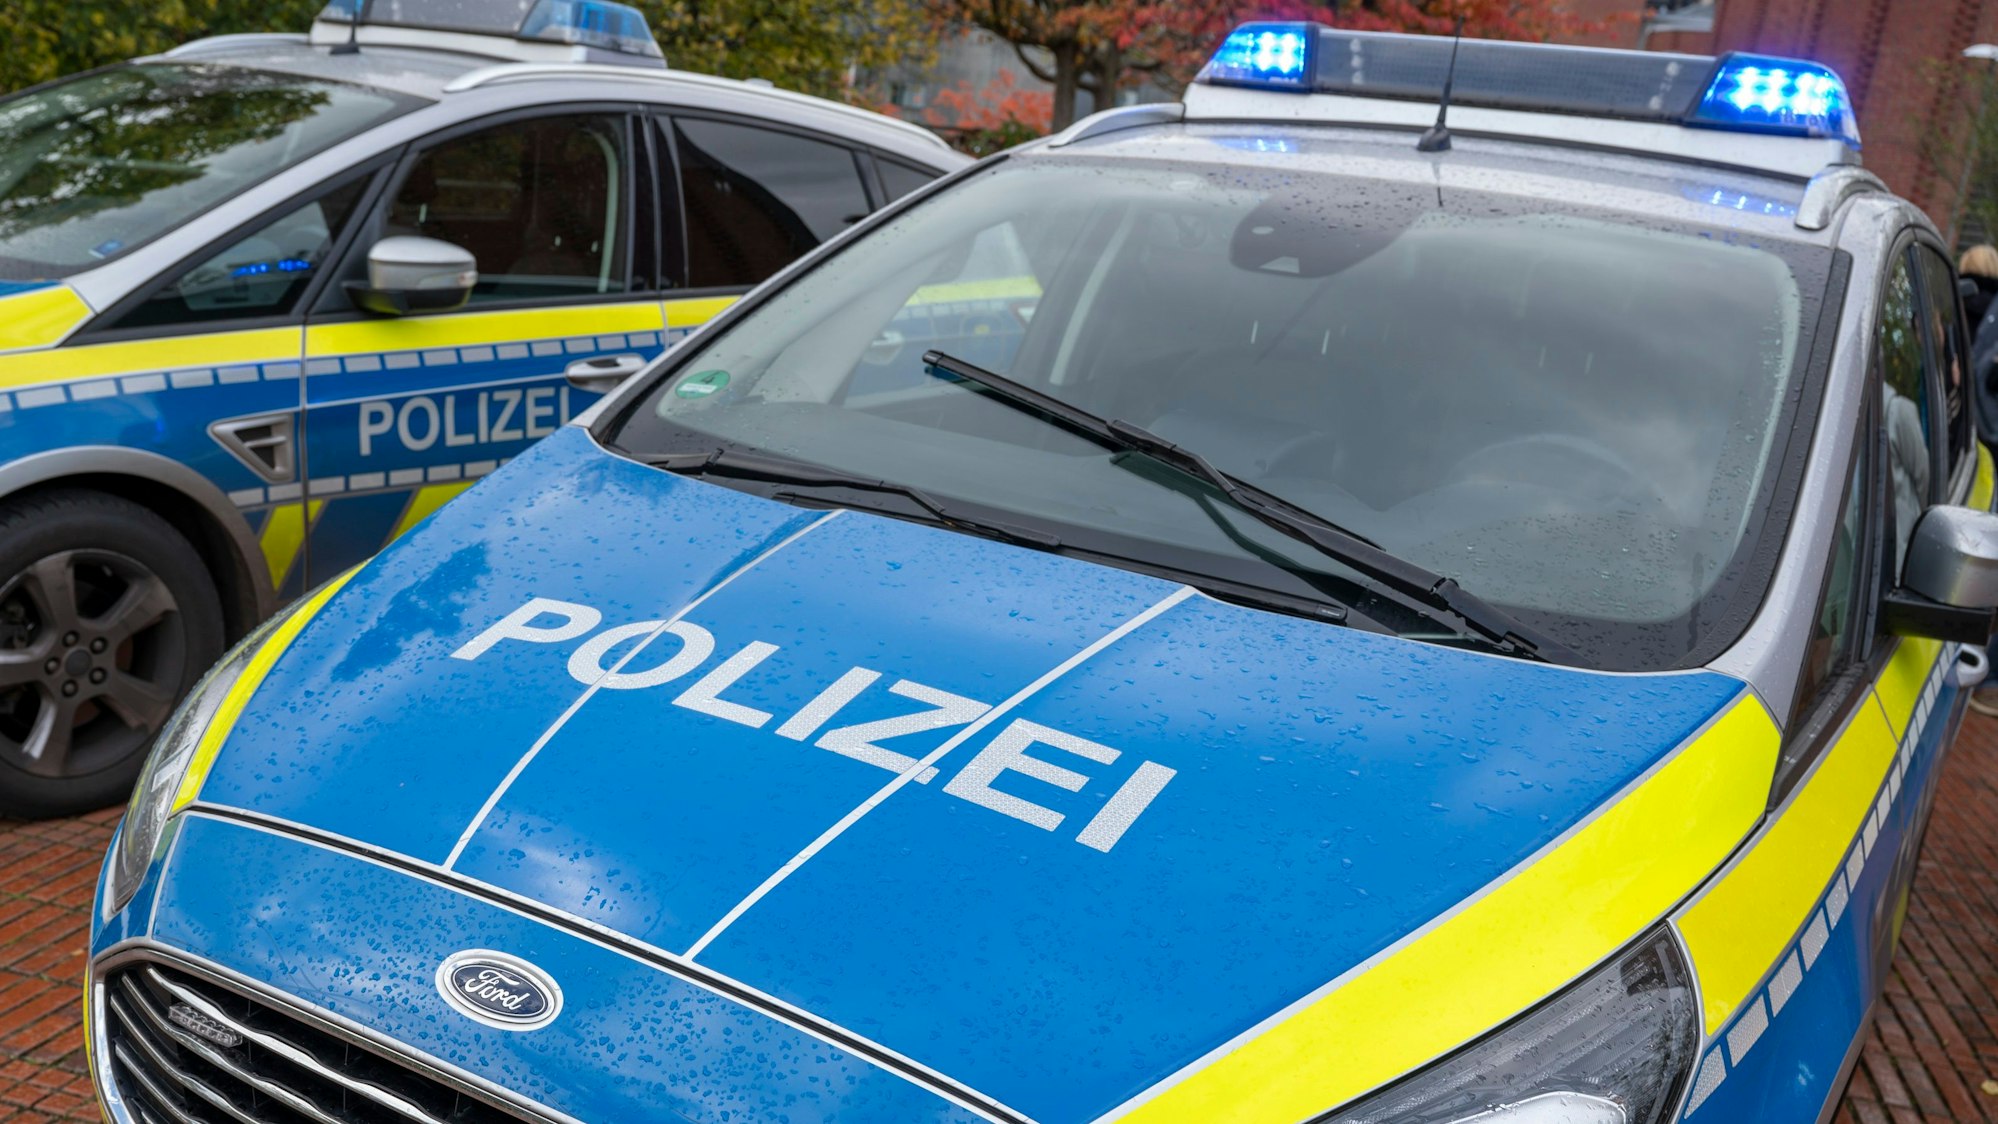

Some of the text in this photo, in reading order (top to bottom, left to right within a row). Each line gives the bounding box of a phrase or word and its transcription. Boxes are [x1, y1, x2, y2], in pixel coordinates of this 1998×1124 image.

[359, 386, 570, 456] POLIZEI
[449, 597, 1178, 854] POLIZEI
[464, 969, 531, 1010] Ford
